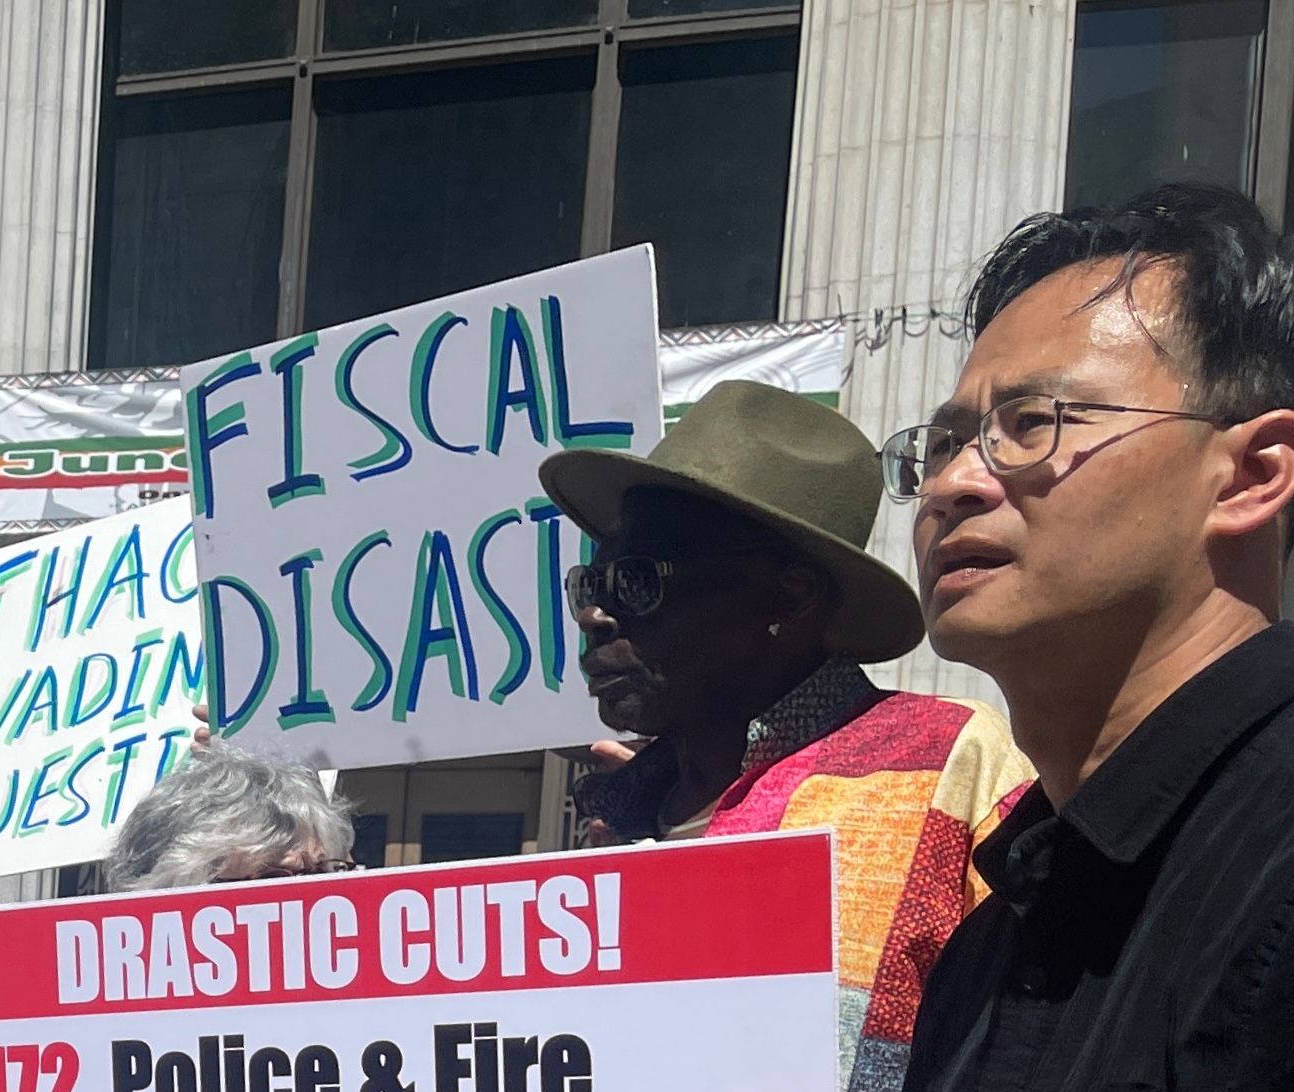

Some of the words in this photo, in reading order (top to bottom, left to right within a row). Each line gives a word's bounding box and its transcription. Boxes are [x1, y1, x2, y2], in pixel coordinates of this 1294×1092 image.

[185, 295, 634, 519] FISCAL
[202, 497, 597, 739] DISAST
[55, 895, 359, 1005] DRASTIC
[380, 872, 622, 987] CUTS!
